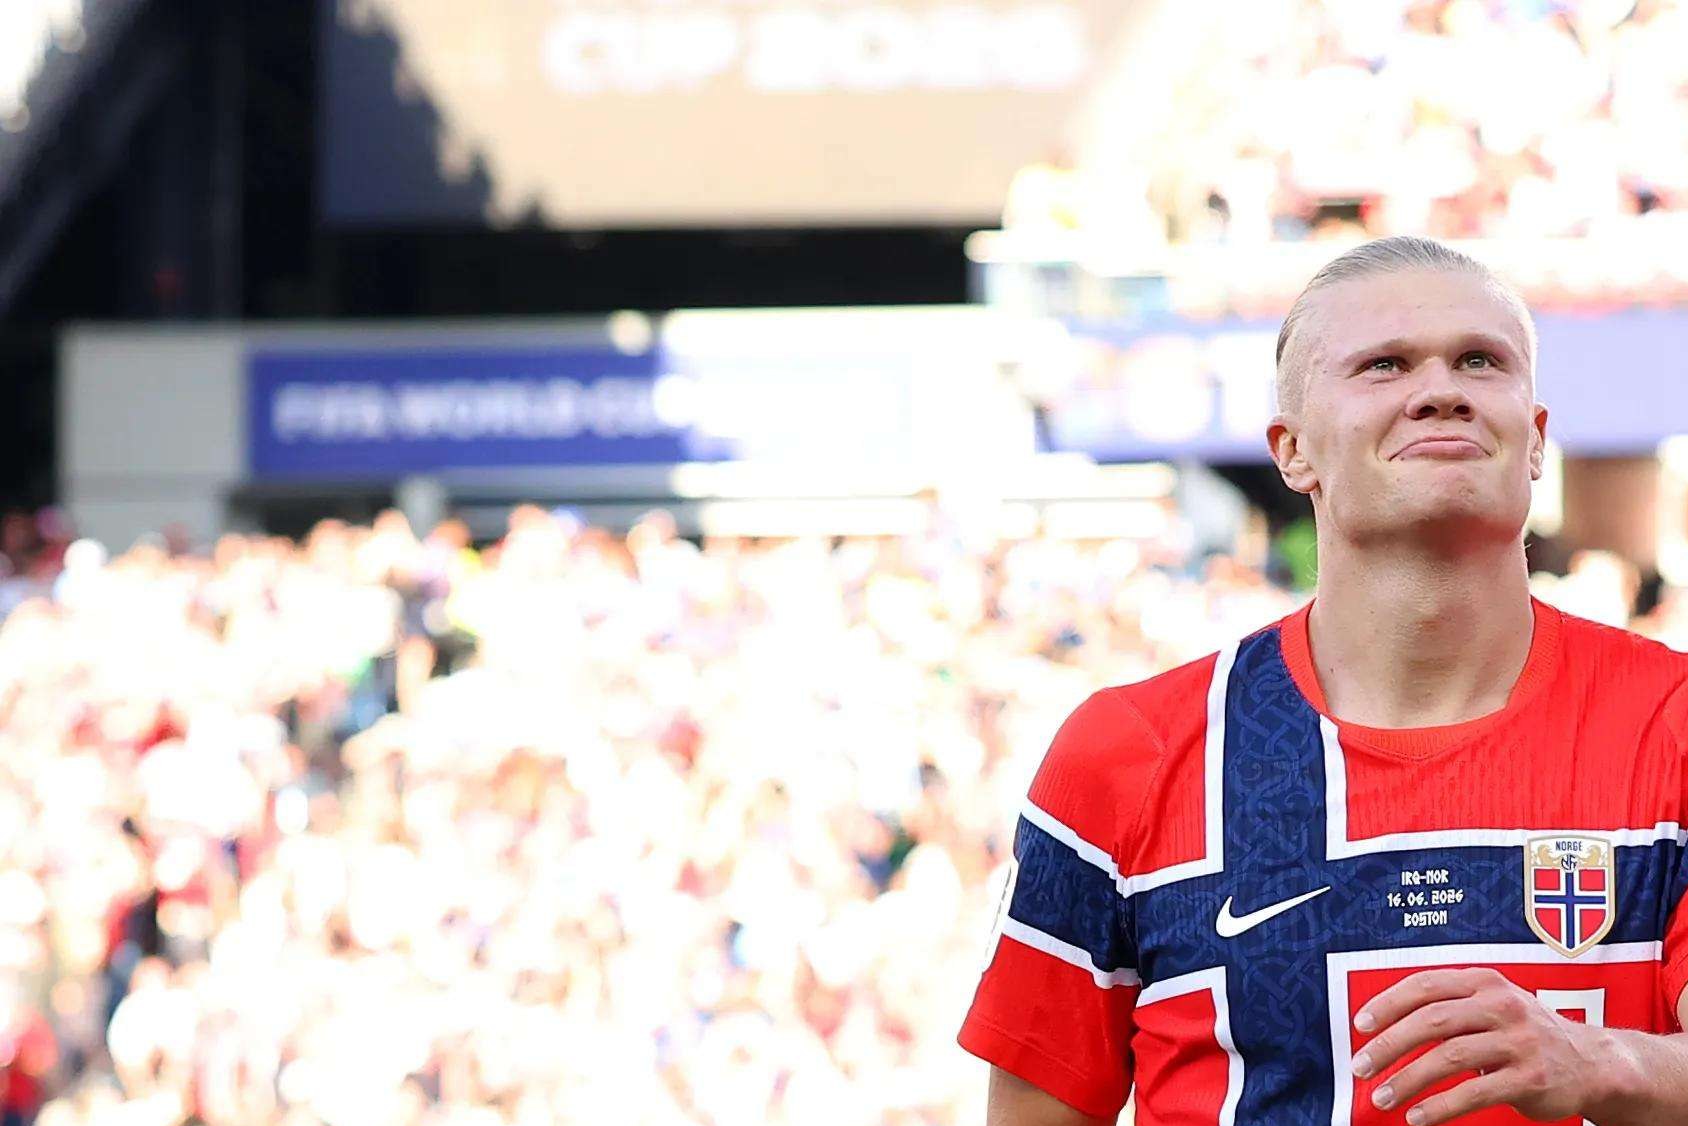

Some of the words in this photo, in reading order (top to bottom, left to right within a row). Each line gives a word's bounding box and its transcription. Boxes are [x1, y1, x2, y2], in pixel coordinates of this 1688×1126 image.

[1555, 840, 1583, 852] NORGE
[1401, 869, 1449, 886] IRQ-NOR
[1403, 910, 1448, 928] BOSTON
